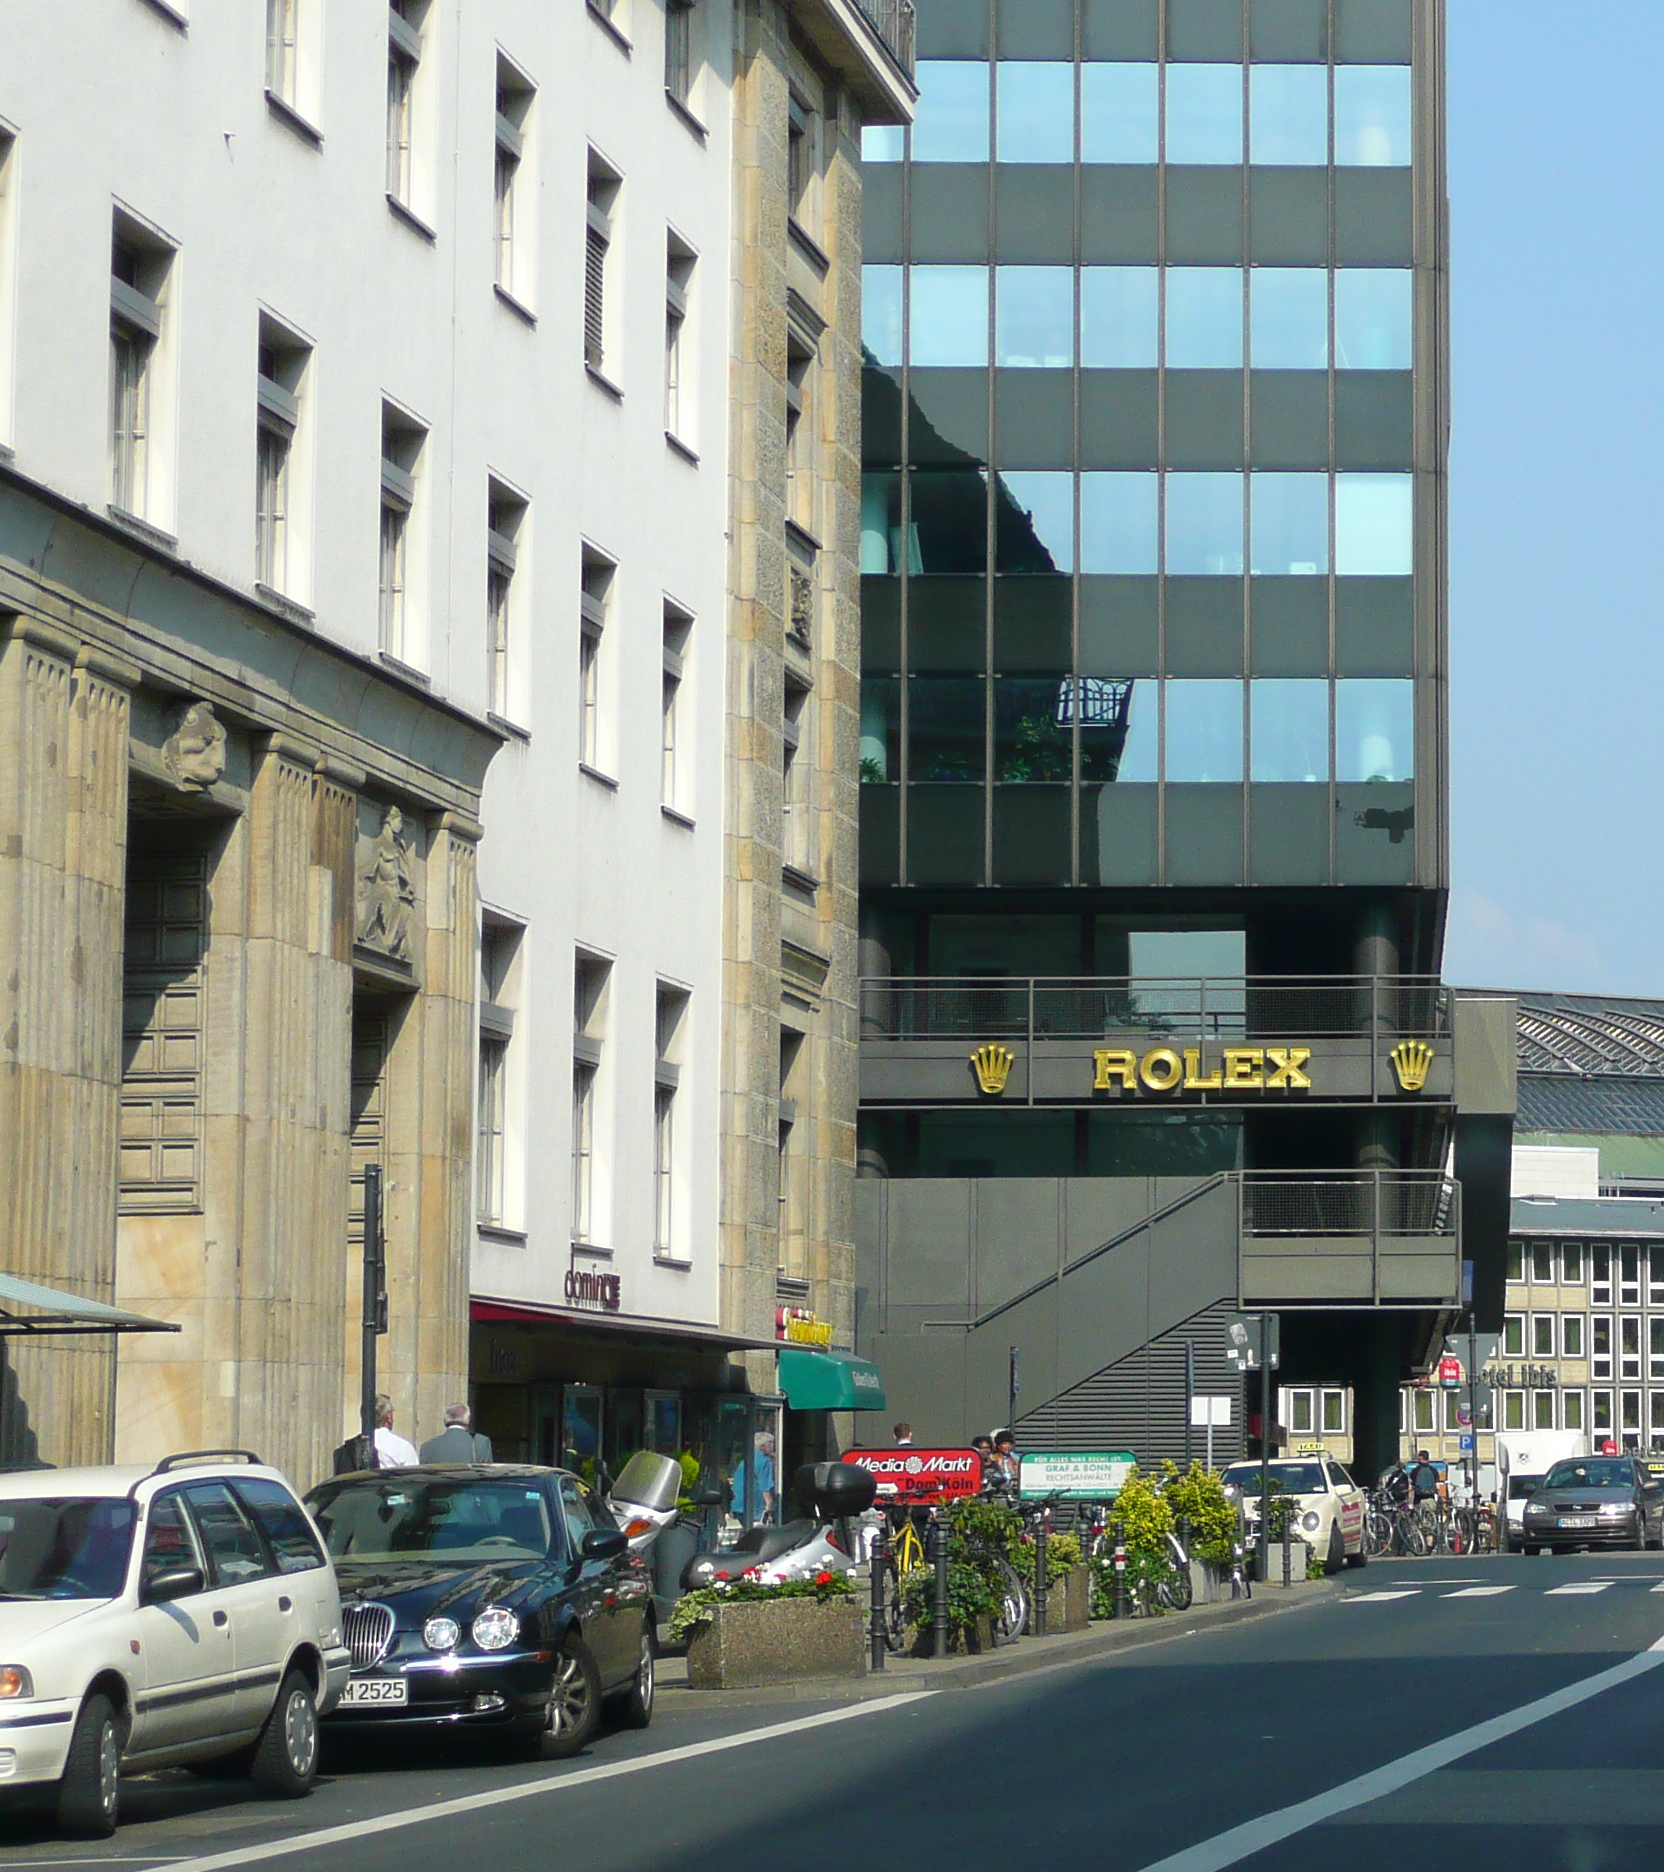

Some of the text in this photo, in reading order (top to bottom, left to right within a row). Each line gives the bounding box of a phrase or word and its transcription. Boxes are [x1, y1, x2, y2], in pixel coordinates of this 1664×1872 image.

[1094, 1048, 1312, 1091] ROLEX
[1521, 1364, 1557, 1388] ibis
[1462, 1436, 1471, 1448] P
[855, 1457, 973, 1473] Media Markt
[1045, 1464, 1069, 1472] GRAF
[1083, 1464, 1112, 1472] BONN
[905, 1476, 973, 1491] Dom Köln
[1045, 1472, 1112, 1481] RECHTSANWÄLTE
[358, 1682, 404, 1700] 2525
